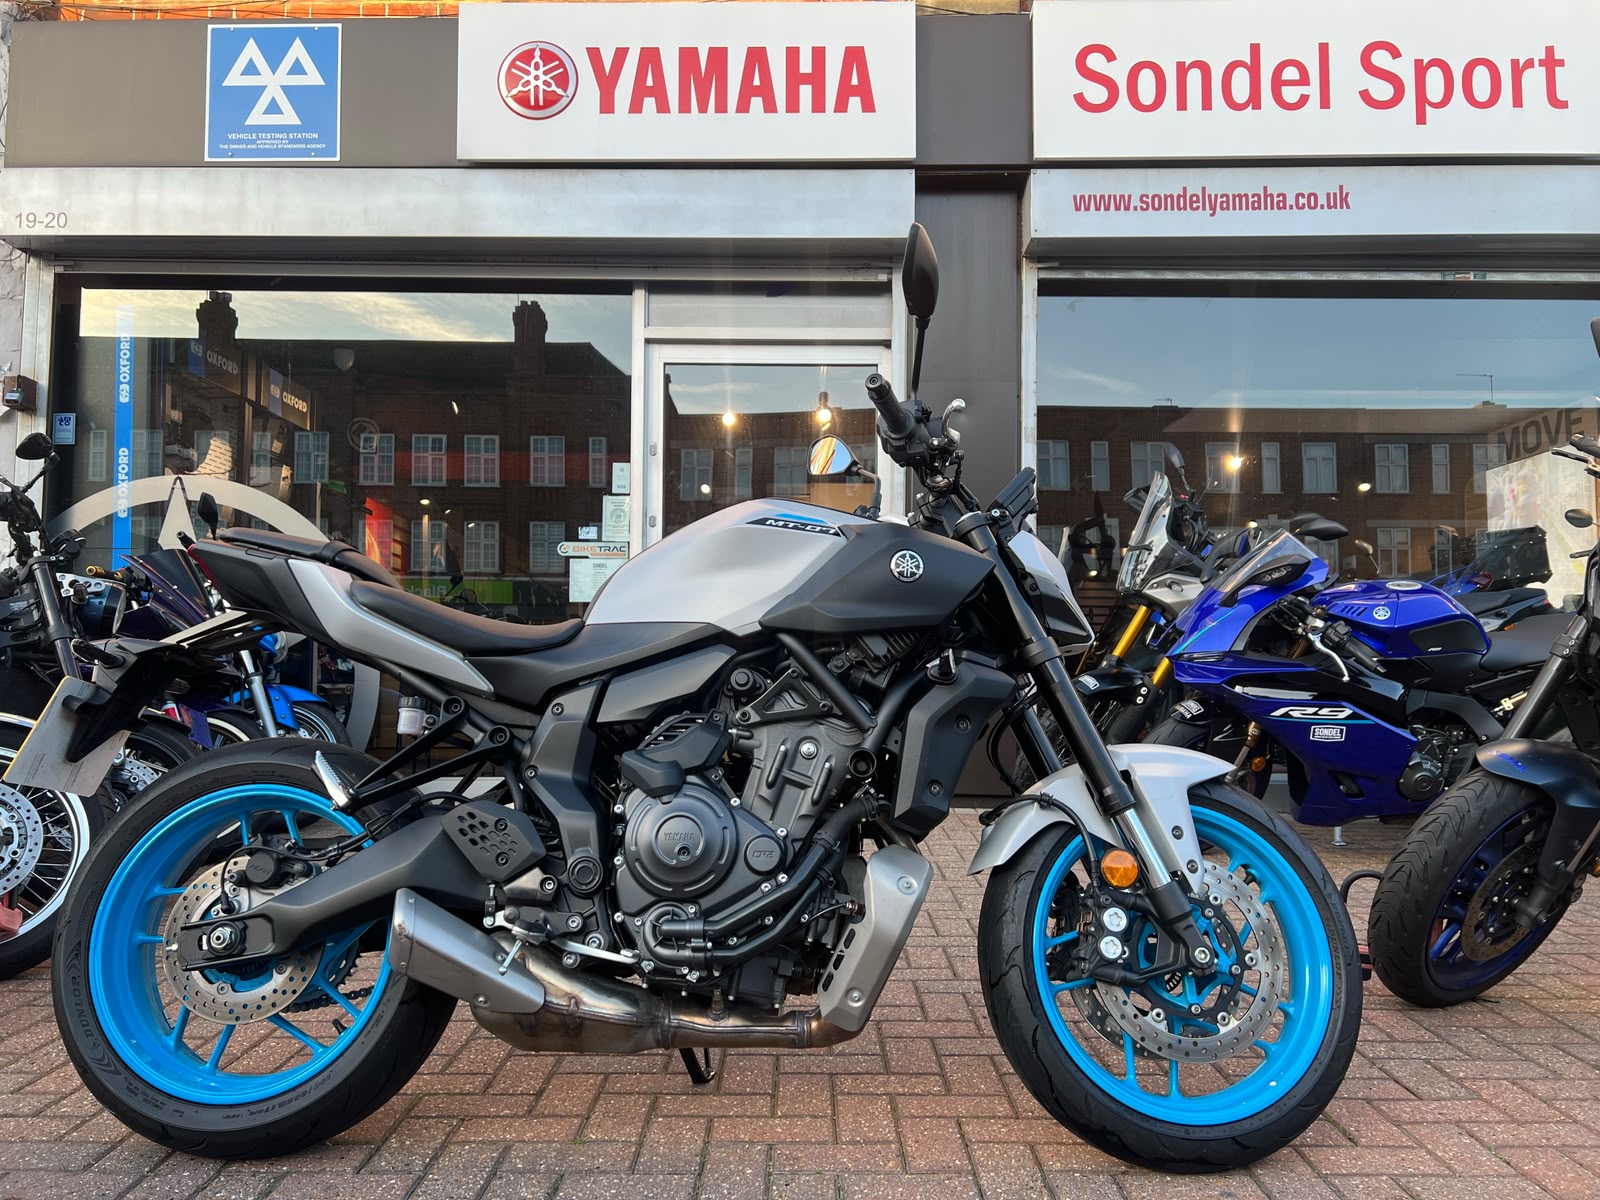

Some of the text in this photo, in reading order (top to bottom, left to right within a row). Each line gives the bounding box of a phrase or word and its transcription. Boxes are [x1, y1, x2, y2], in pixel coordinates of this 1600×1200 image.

[585, 46, 876, 114] YAMAHA
[1073, 40, 1569, 125] Sondel Sport
[1073, 185, 1350, 216] www.sondelyamaha.co.uk
[15, 212, 68, 229] 19-20
[119, 333, 131, 383] OXFORD
[206, 350, 239, 375] OXFORD
[282, 391, 308, 413] OXFORD
[1496, 408, 1583, 461] MOVE
[117, 447, 129, 498] OXFORD
[765, 519, 837, 534] MT-07
[572, 545, 627, 553] BIKETRAC
[1269, 706, 1354, 719] R9
[1314, 727, 1342, 736] SONDEL
[663, 832, 695, 841] YAMAHA
[71, 975, 94, 1039] DUNLOP
